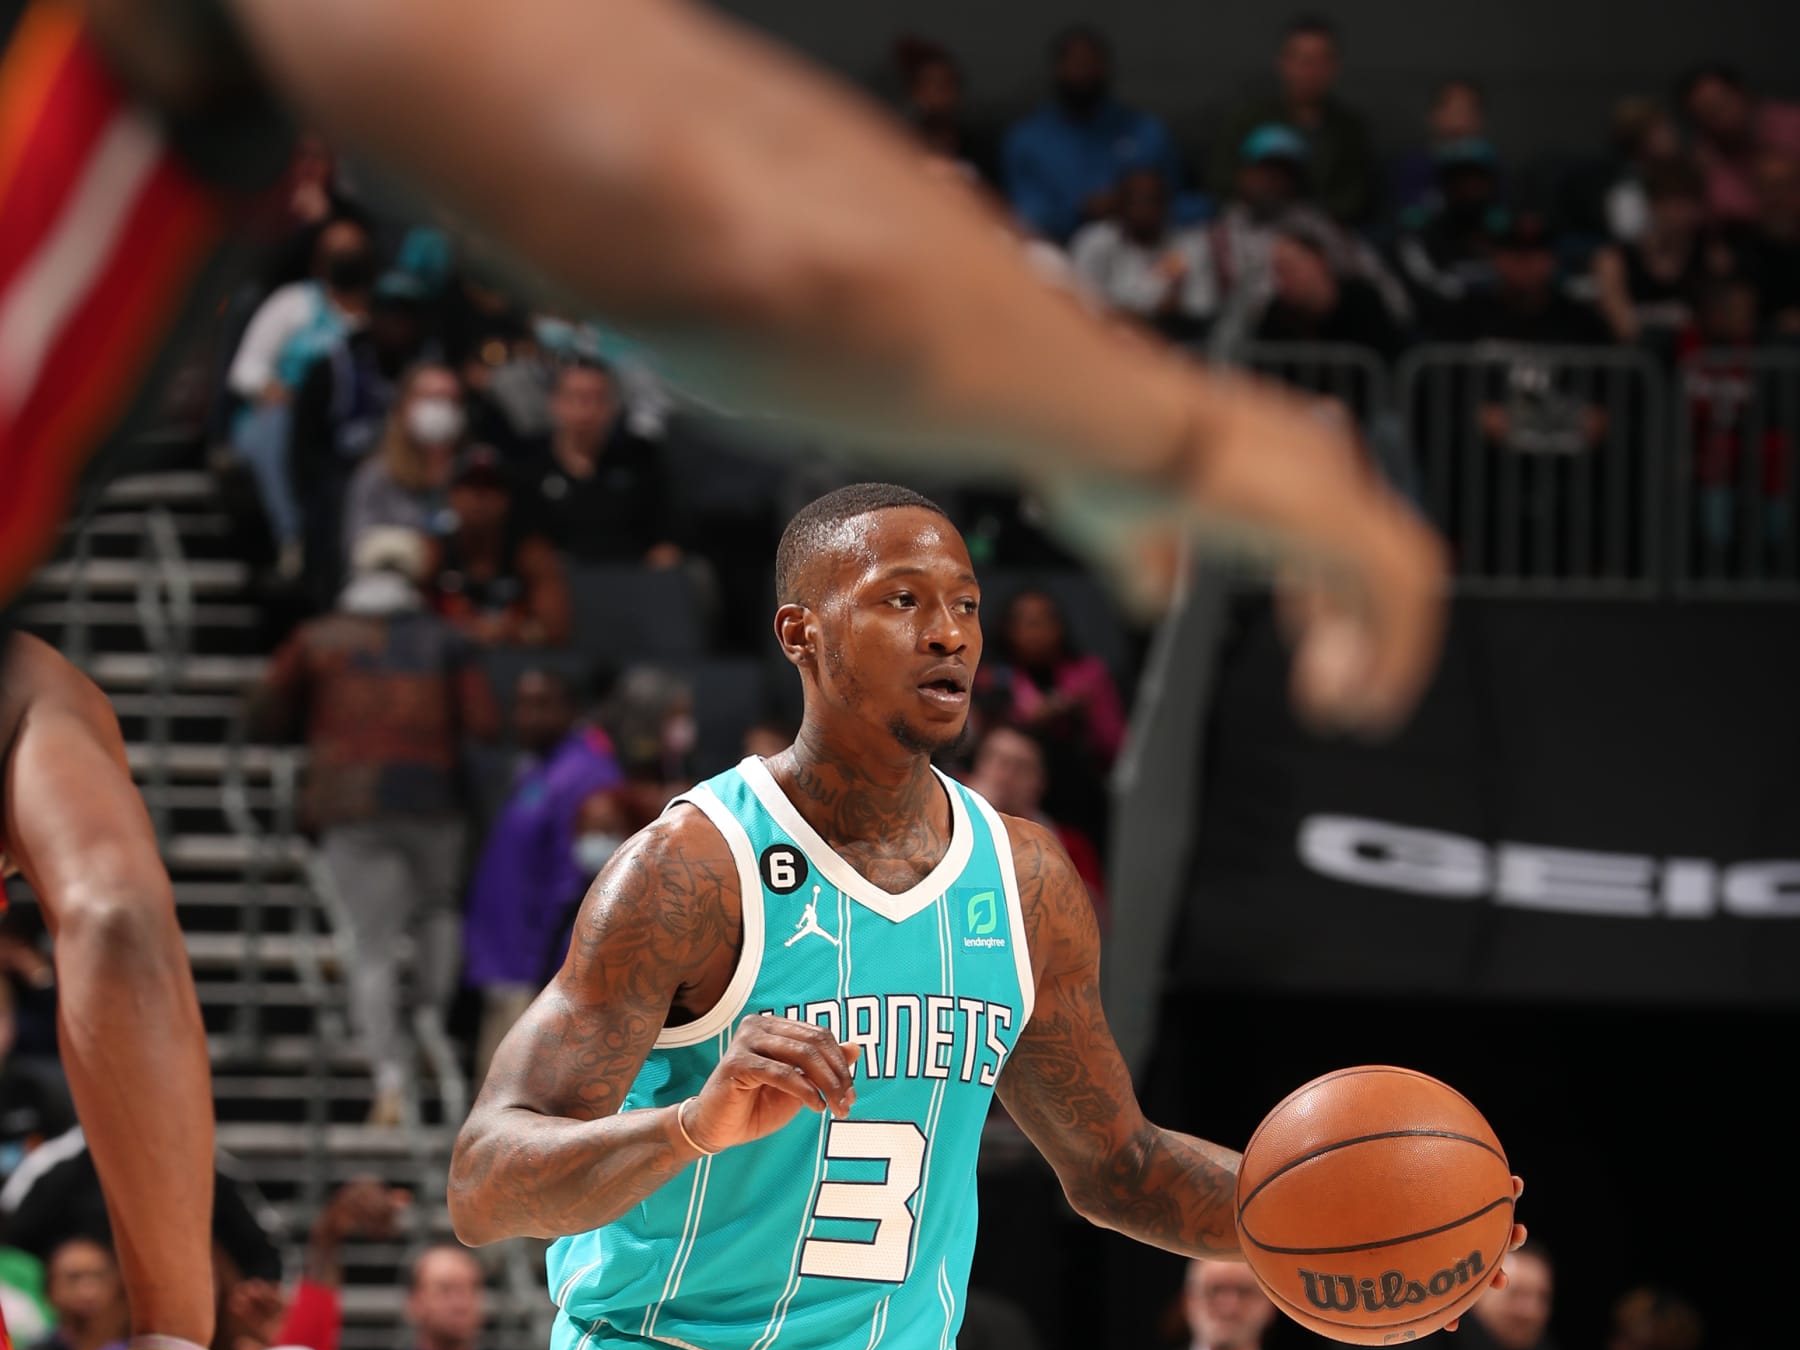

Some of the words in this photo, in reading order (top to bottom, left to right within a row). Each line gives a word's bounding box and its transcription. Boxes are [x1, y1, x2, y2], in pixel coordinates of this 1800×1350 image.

[769, 851, 796, 888] 6
[963, 936, 1006, 949] lendingtree
[758, 993, 1013, 1088] RNETS
[799, 1118, 928, 1284] 3
[1297, 1249, 1485, 1312] Wilson
